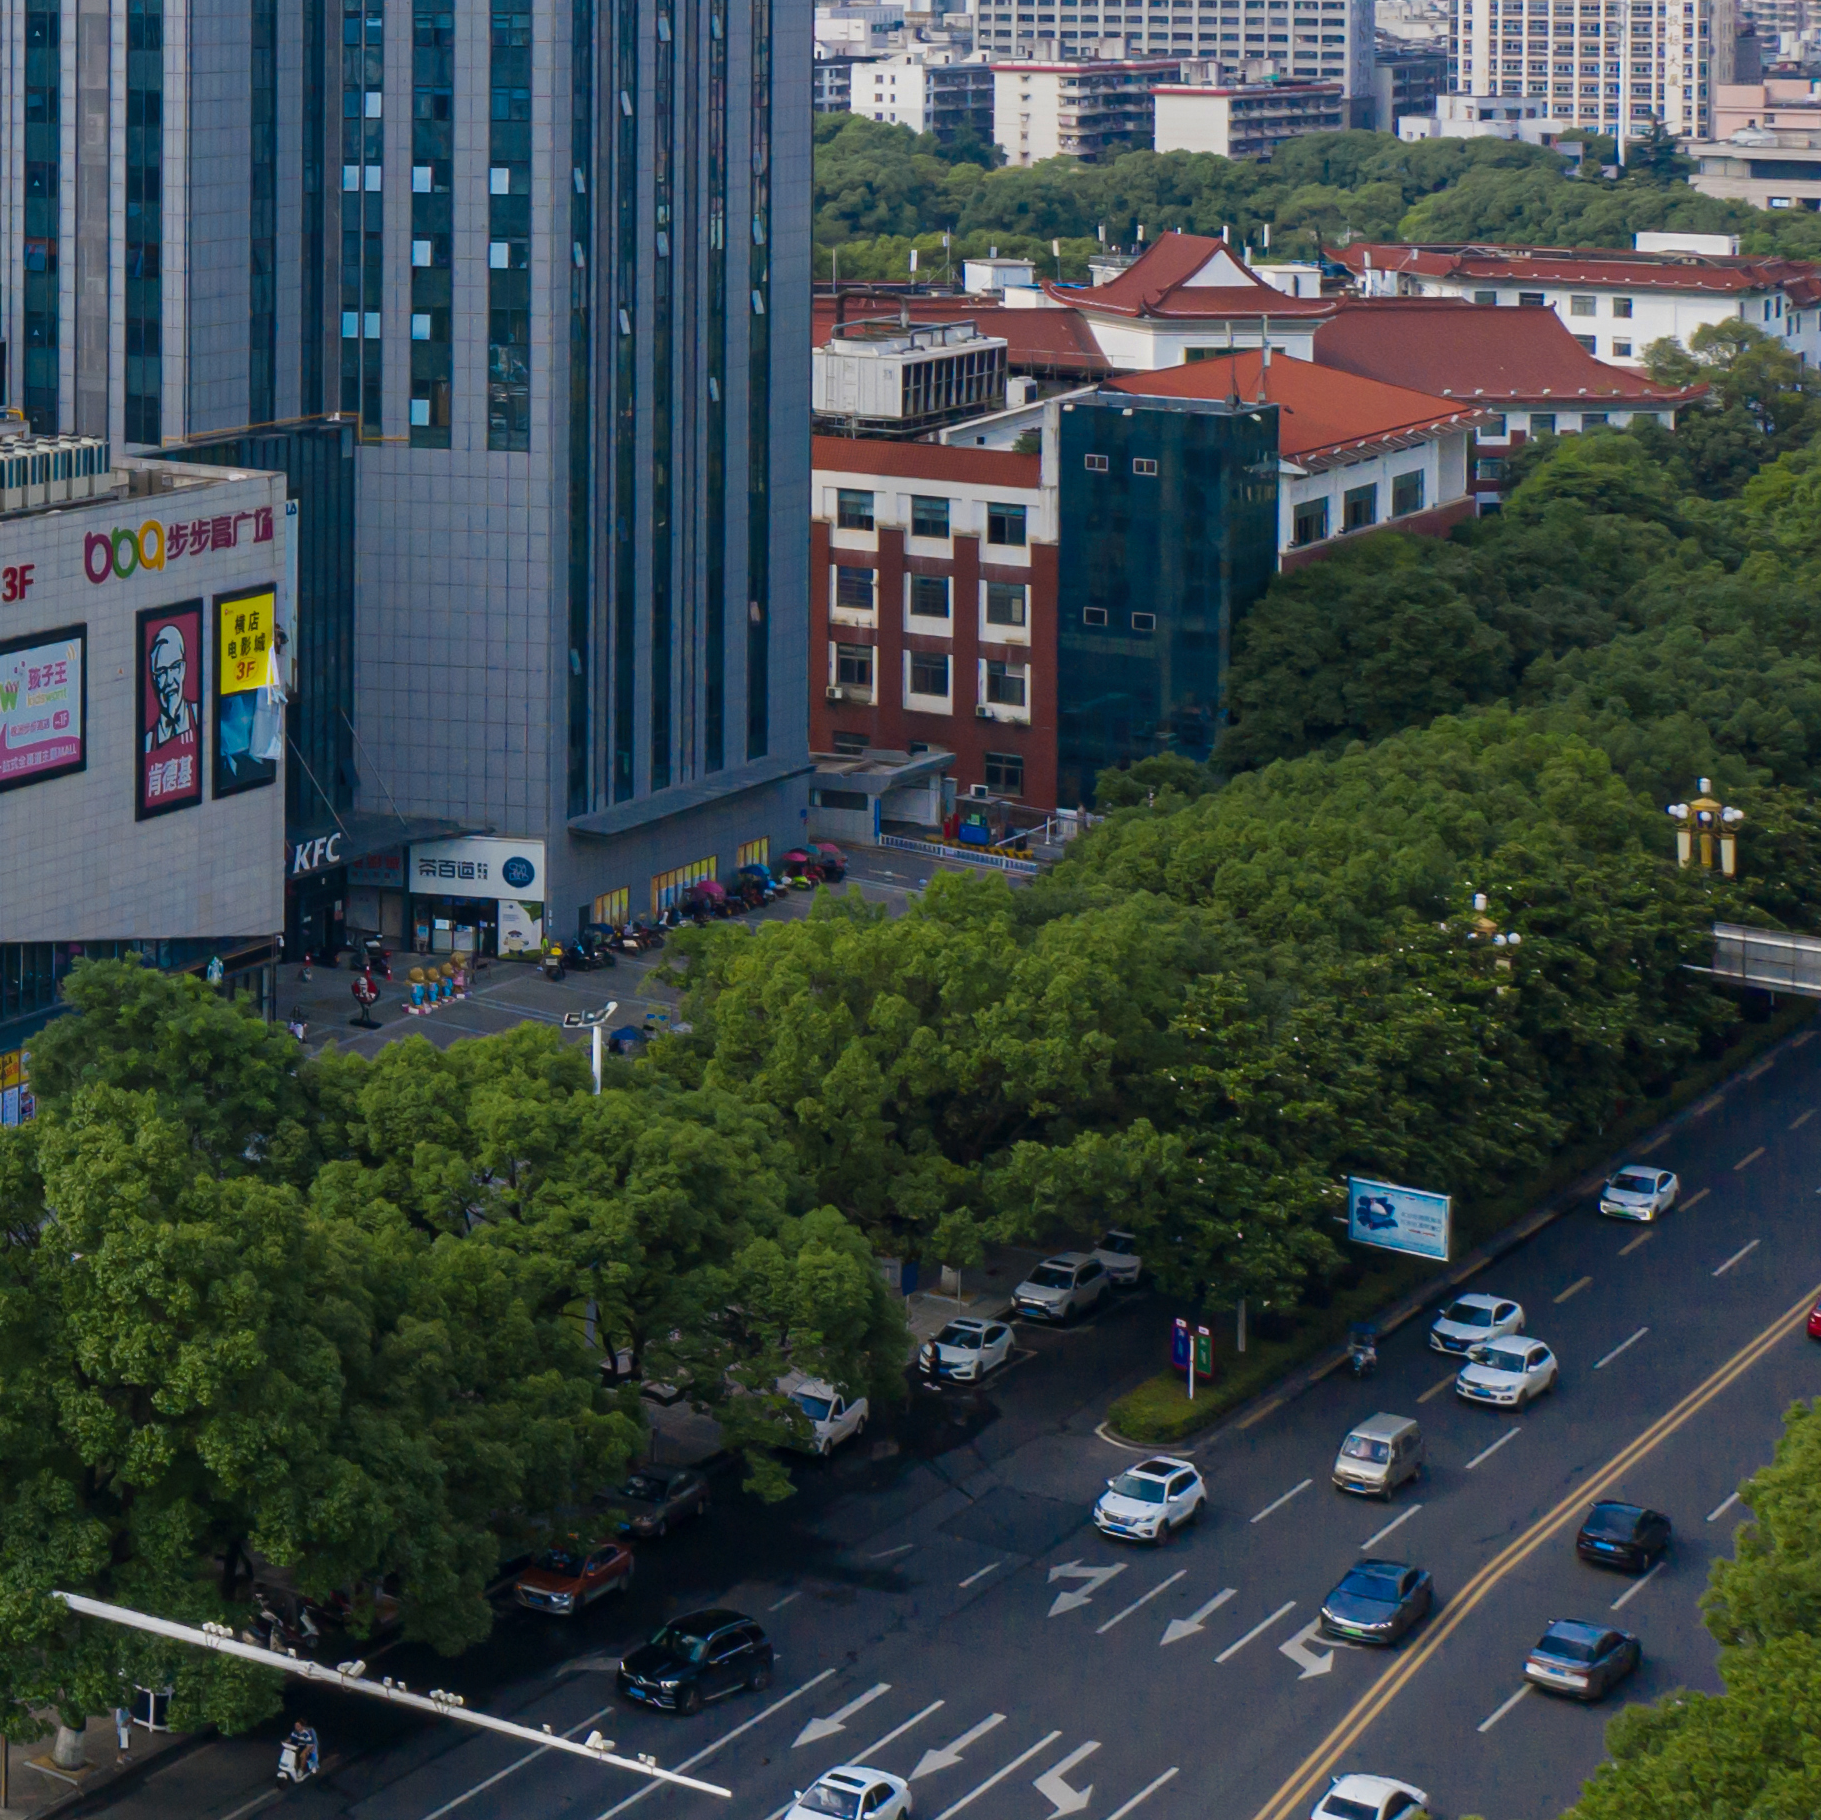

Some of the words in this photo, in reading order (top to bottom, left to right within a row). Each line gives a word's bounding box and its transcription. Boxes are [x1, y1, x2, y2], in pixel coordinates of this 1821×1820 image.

[167, 506, 274, 561] 步步高广场
[1, 563, 36, 603] 3F
[28, 661, 68, 691] 孩子王
[236, 660, 257, 681] 3F
[148, 754, 193, 798] 肯德基
[293, 832, 341, 874] KFC
[419, 858, 475, 880] 茶百道
